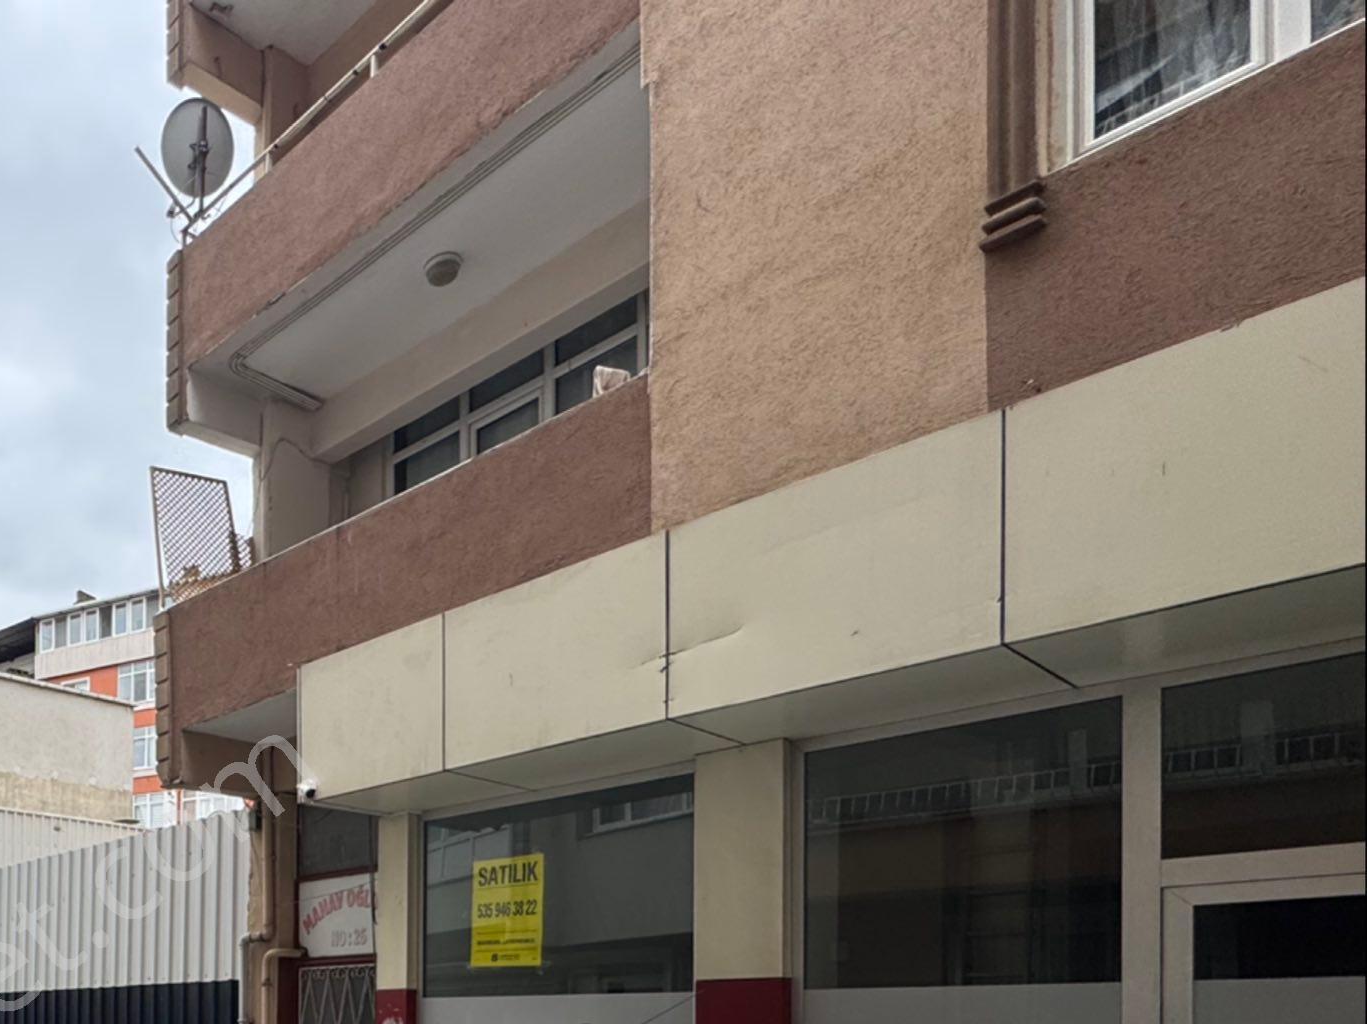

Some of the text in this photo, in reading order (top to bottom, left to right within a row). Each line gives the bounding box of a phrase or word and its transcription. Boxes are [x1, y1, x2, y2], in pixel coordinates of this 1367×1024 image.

[478, 860, 539, 887] SATILIK
[477, 902, 493, 919] 535
[525, 898, 538, 916] 22
